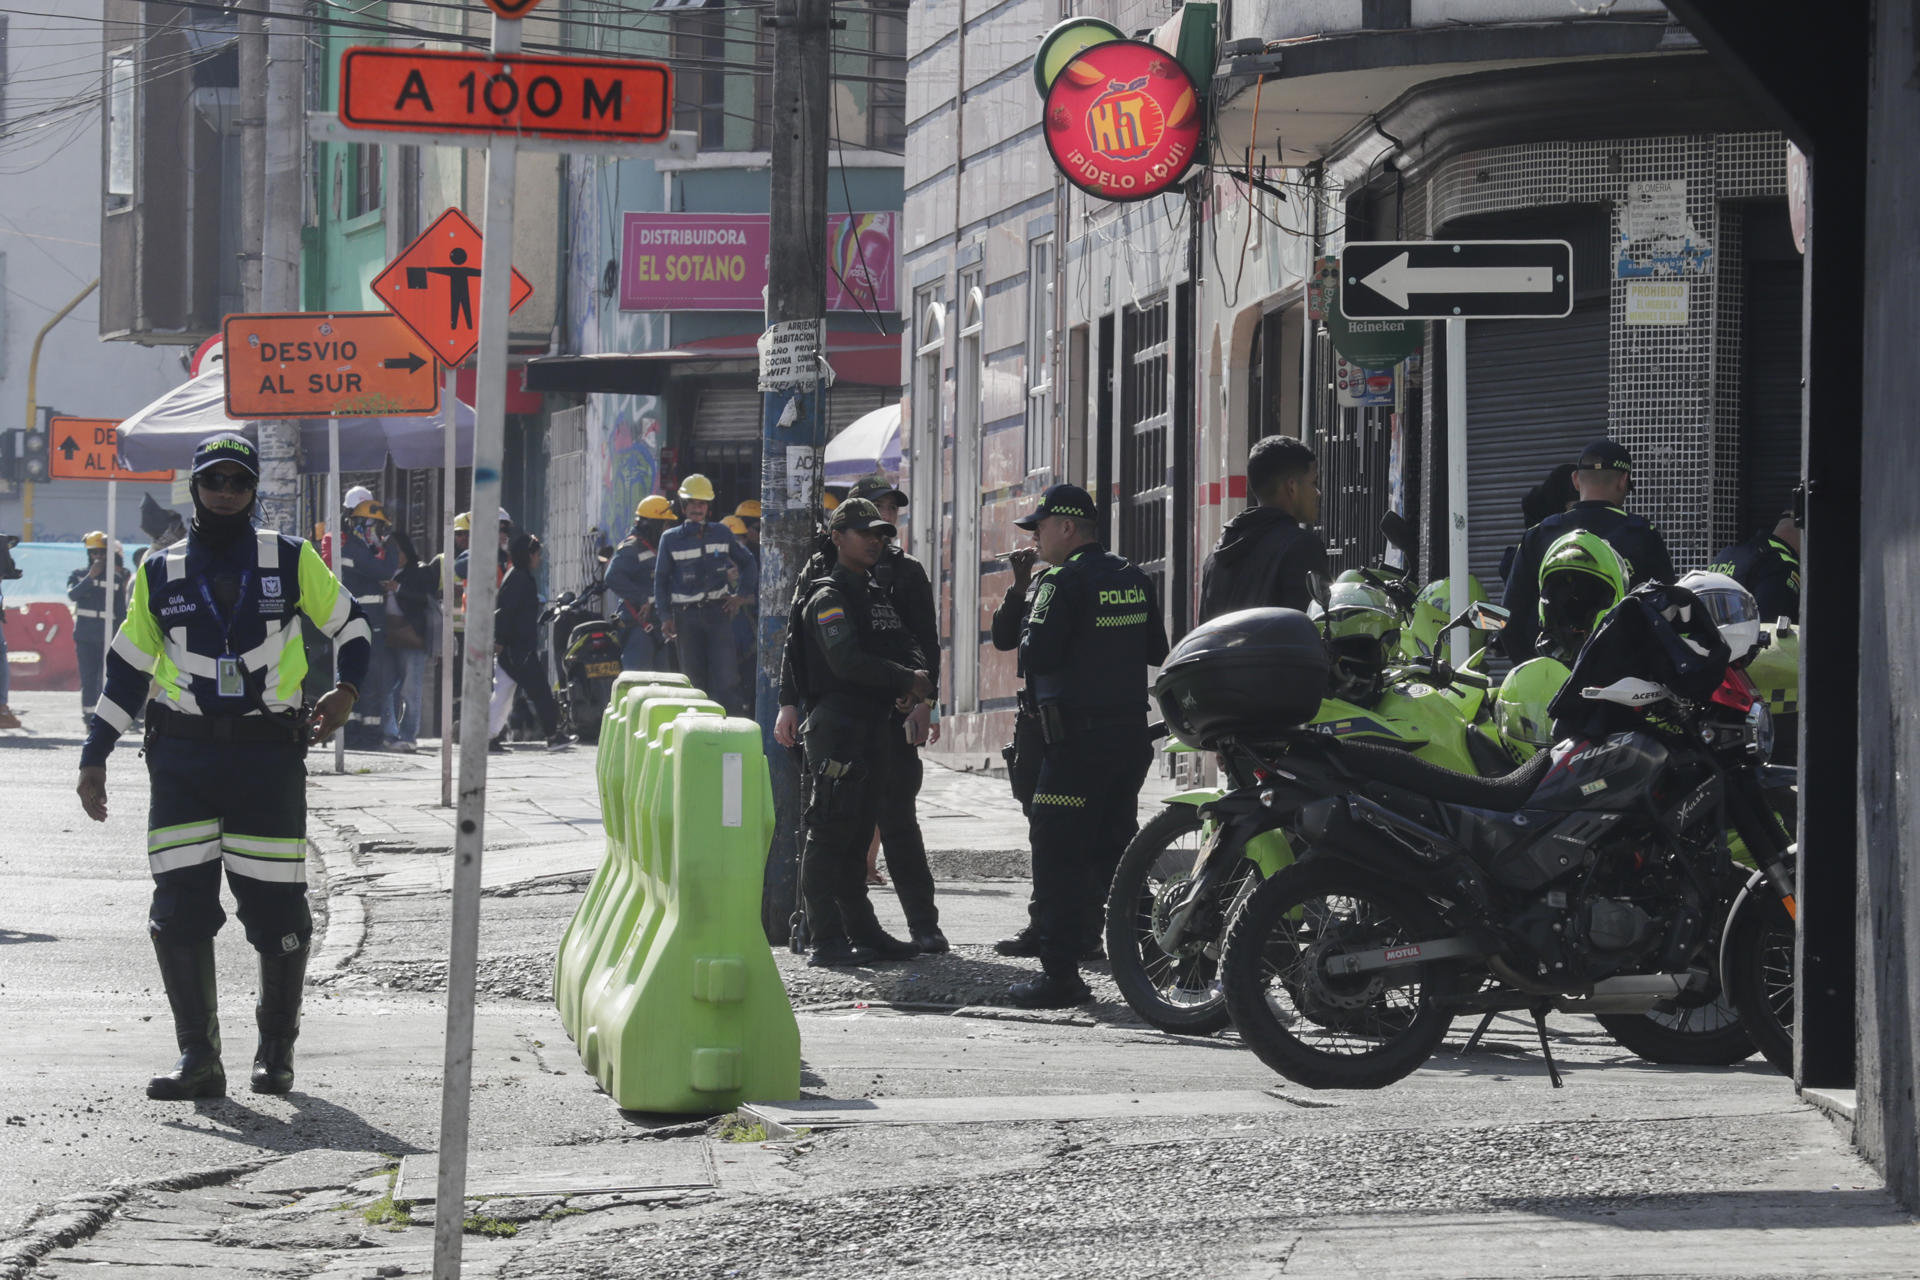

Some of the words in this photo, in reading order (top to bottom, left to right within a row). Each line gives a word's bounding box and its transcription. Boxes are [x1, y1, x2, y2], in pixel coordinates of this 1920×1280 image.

[394, 69, 434, 111] A
[459, 71, 563, 118] 100
[582, 78, 623, 121] M
[1067, 149, 1136, 188] ¡PÍDELO
[1143, 141, 1187, 185] AQUÍ!
[640, 229, 746, 245] DISTRIBUIDORA
[640, 255, 660, 281] EL
[665, 254, 745, 282] SOTANO
[1631, 286, 1684, 297] PROHIBIDO
[1348, 321, 1405, 334] Heineken
[260, 341, 357, 362] DESVIO
[766, 366, 791, 376] WIFI
[259, 375, 294, 394] AL
[308, 373, 363, 393] SUR
[205, 440, 250, 455] MOVILIDAD
[84, 453, 106, 470] AL
[168, 594, 185, 605] GUÍA
[1099, 584, 1147, 604] POLICÍA
[160, 603, 197, 617] MOVILIDAD
[1386, 947, 1419, 960] MOTUL
